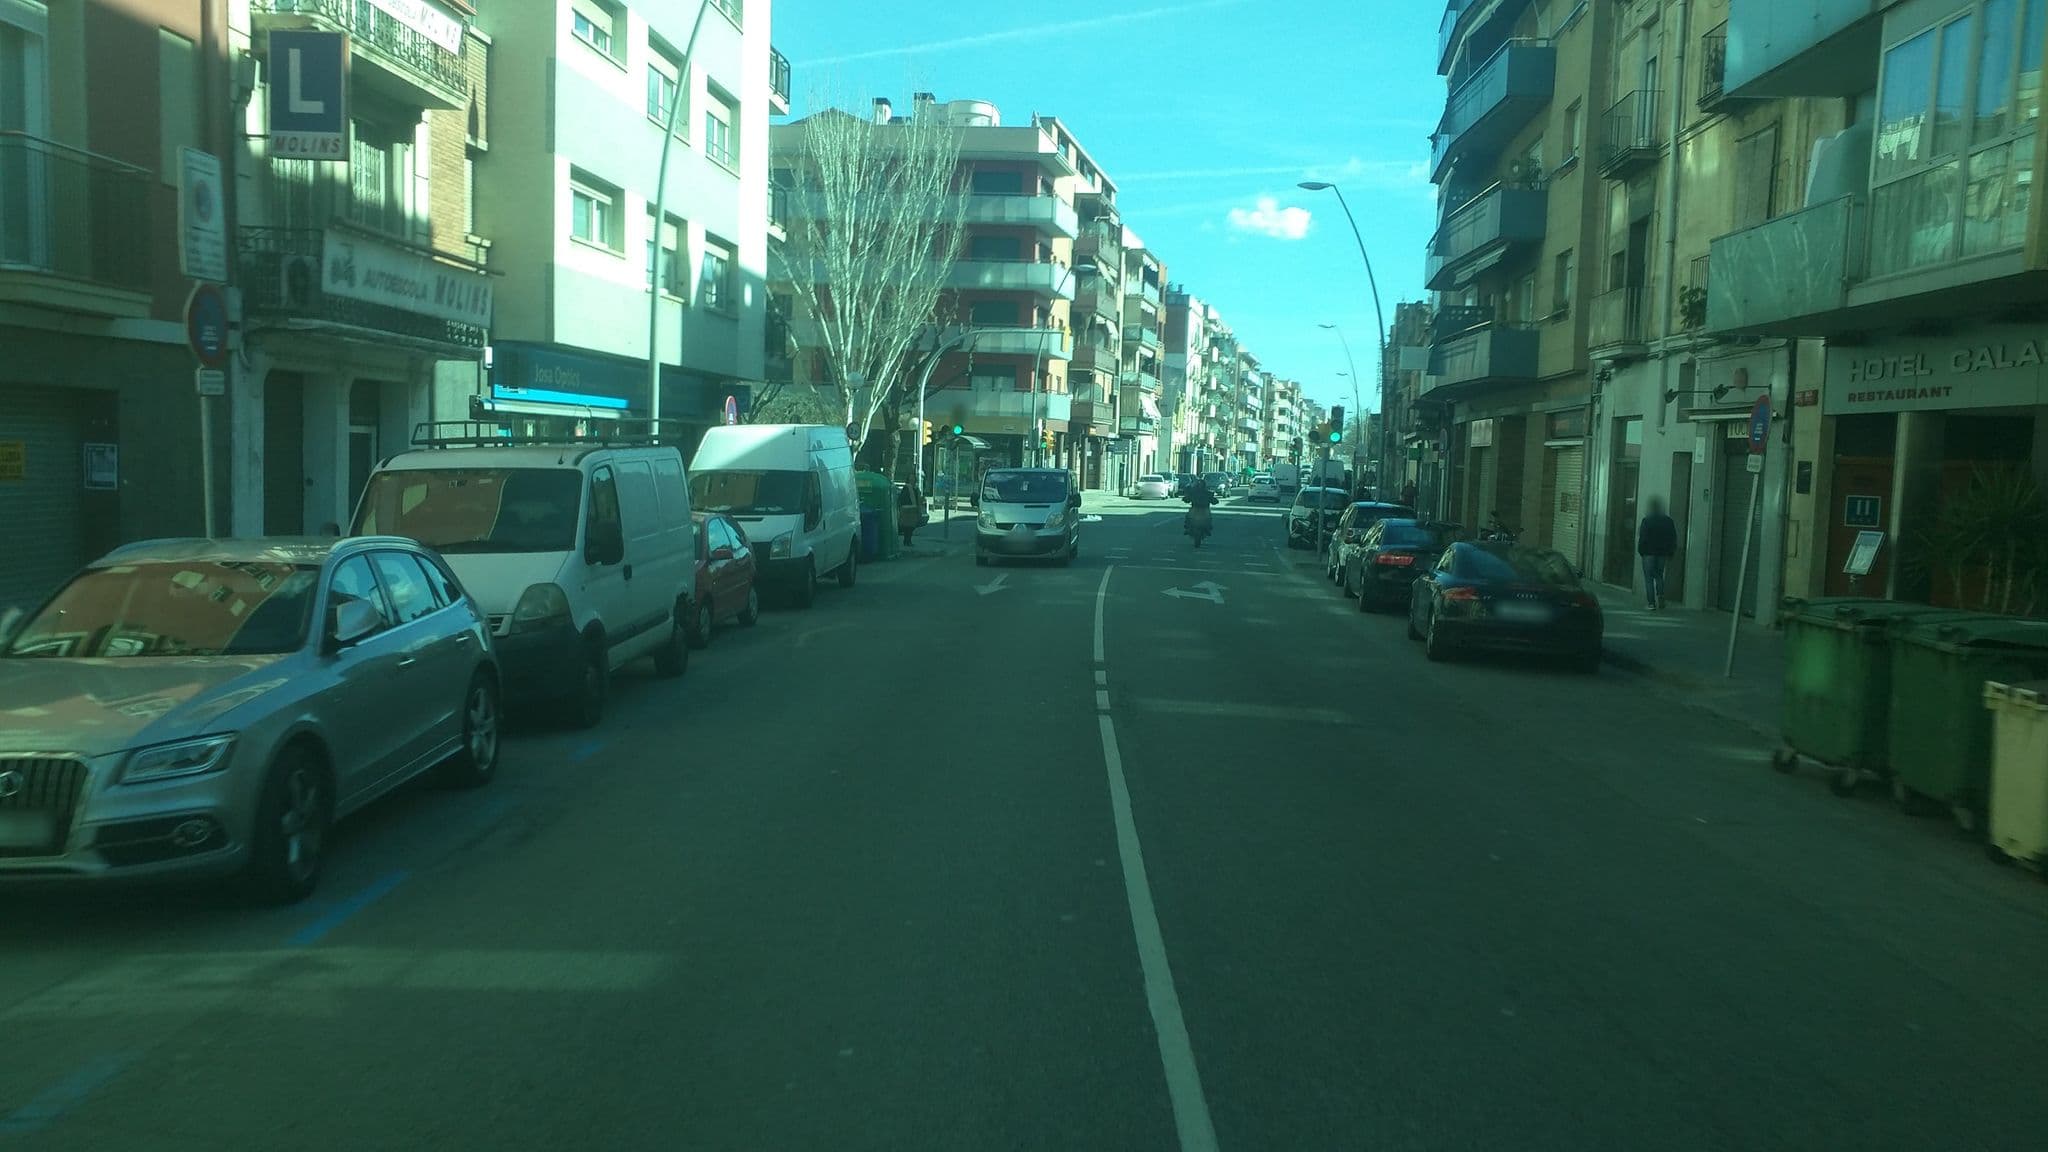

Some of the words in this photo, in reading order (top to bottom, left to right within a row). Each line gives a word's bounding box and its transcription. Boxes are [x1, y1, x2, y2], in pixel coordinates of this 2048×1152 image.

[289, 48, 324, 113] L
[273, 136, 340, 154] MOLINS
[434, 274, 489, 316] MOLINS
[1849, 352, 1933, 383] HOTEL
[1951, 337, 2048, 374] CALA
[1848, 385, 1953, 403] RESTAURANT
